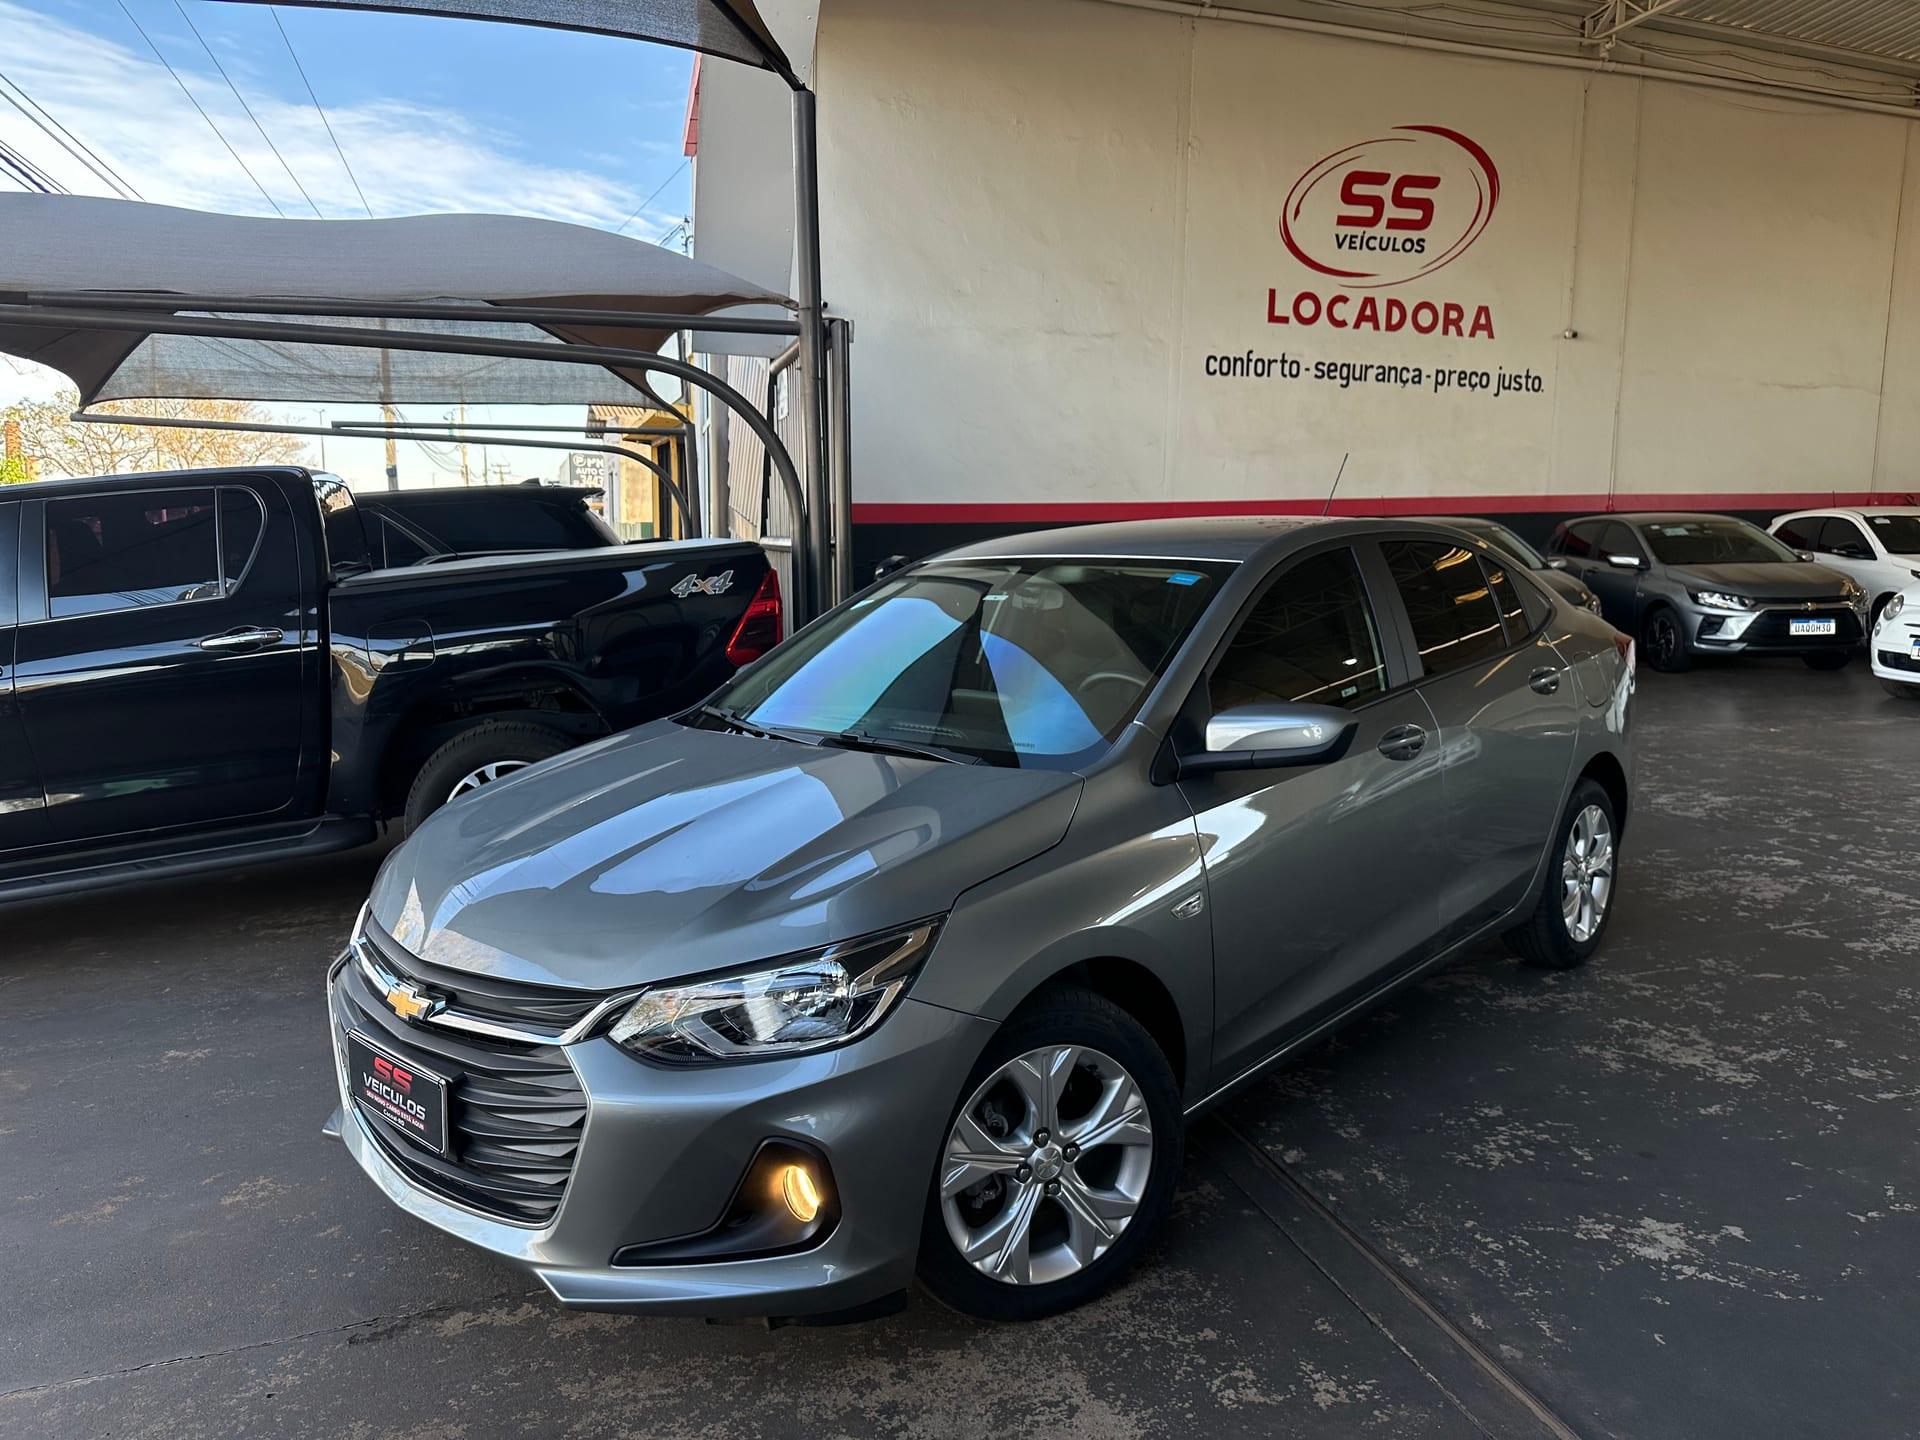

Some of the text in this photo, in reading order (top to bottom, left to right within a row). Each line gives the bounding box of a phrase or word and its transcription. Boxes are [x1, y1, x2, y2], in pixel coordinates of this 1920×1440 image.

[1336, 170, 1441, 231] SS
[1335, 230, 1426, 254] VEÍCULOS
[1267, 287, 1495, 340] LOCADORA
[1205, 350, 1301, 379] conforto
[1313, 360, 1423, 389] segurança
[1433, 368, 1491, 394] preço
[576, 467, 598, 476] AUTO
[362, 1071, 426, 1121] VEICULOS
[373, 1056, 413, 1095] SS
